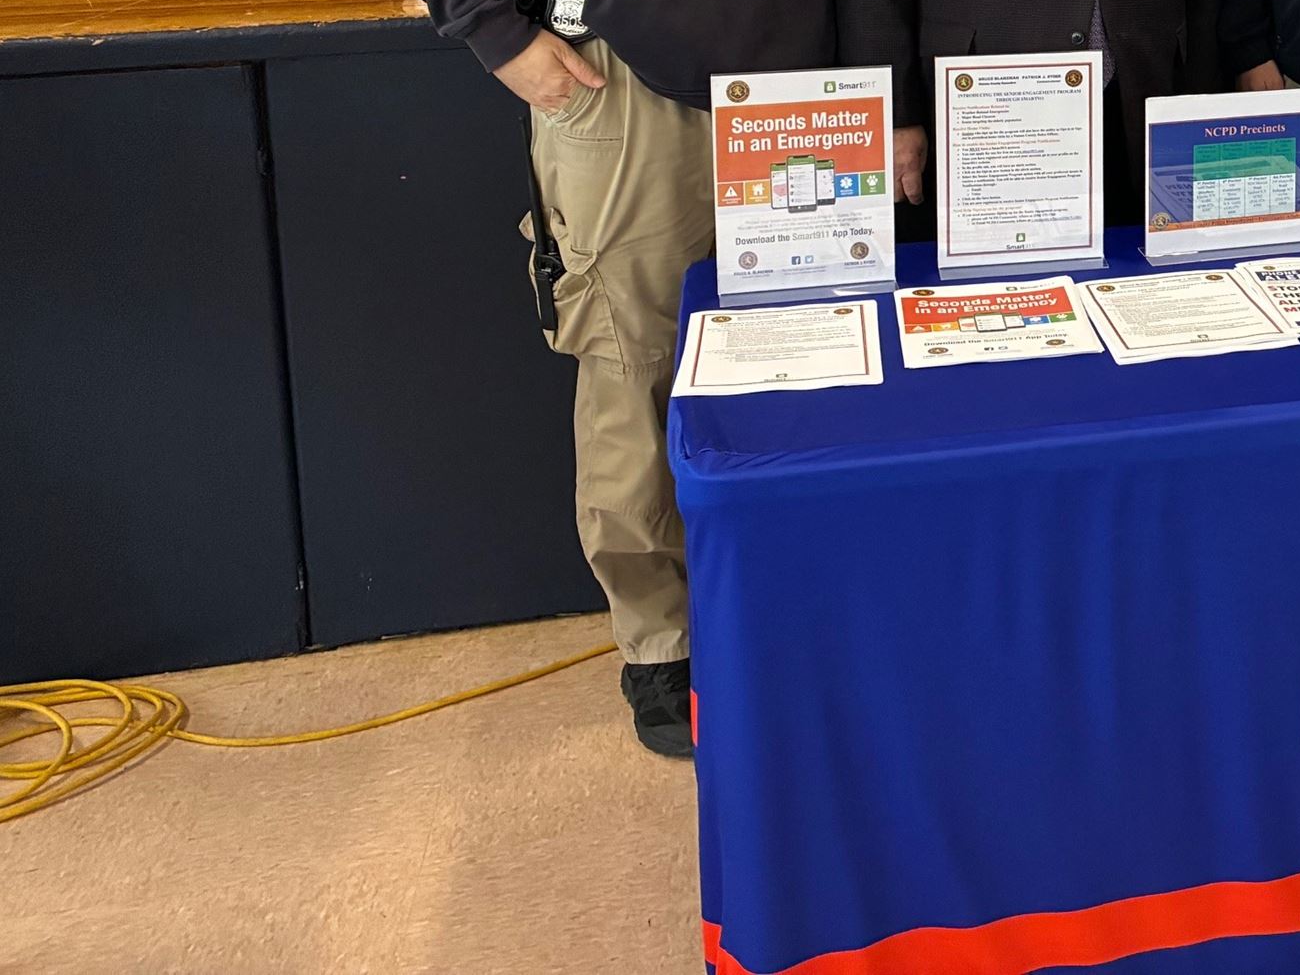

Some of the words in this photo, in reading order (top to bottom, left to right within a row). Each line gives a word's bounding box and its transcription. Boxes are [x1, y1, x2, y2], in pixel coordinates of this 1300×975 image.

[731, 114, 806, 133] Seconds
[811, 111, 868, 128] Matter
[1204, 126, 1237, 138] NCPD
[1240, 124, 1286, 134] Precincts
[728, 136, 744, 153] in
[750, 137, 771, 152] an
[778, 130, 873, 150] Emergency
[735, 236, 775, 245] Download
[792, 231, 829, 241] Smart911
[832, 229, 848, 238] App
[850, 228, 874, 236] Today.
[917, 298, 990, 308] Seconds
[996, 293, 1052, 304] Matter
[963, 298, 1057, 312] Emergency
